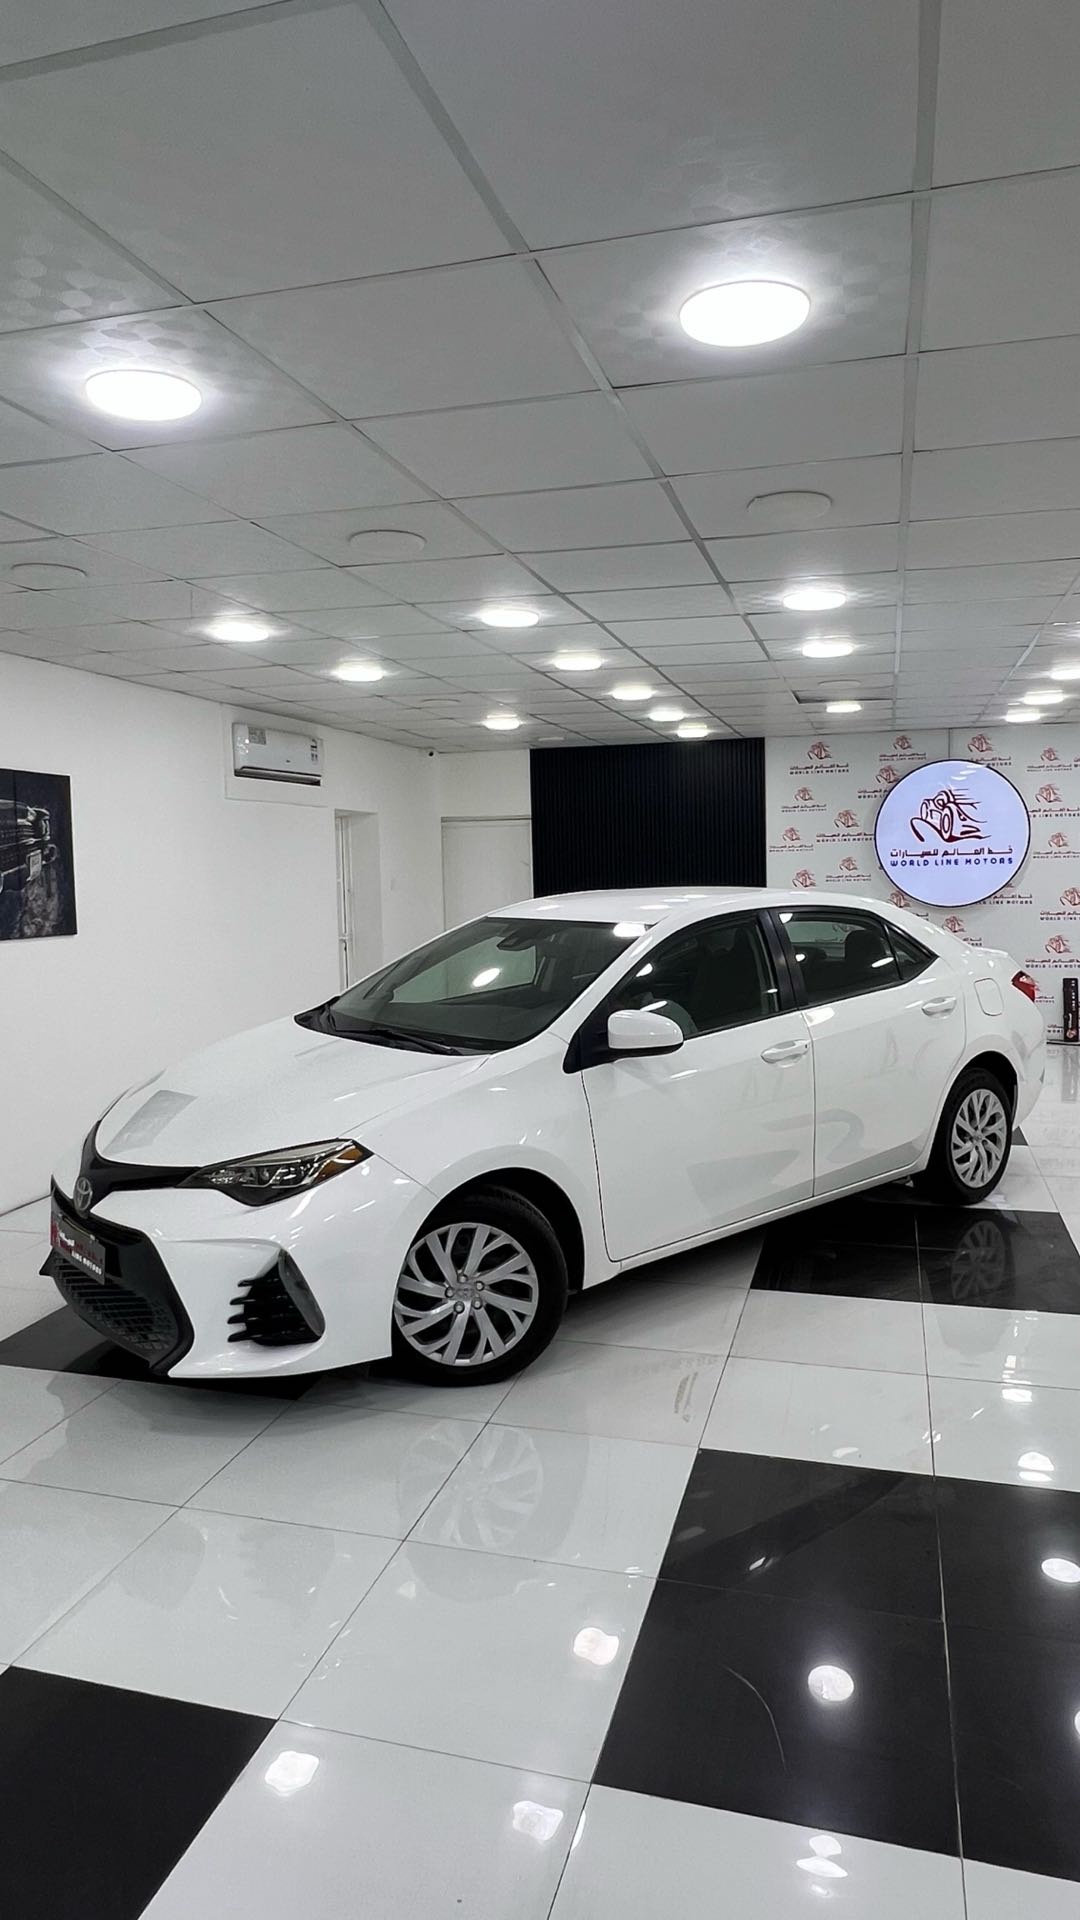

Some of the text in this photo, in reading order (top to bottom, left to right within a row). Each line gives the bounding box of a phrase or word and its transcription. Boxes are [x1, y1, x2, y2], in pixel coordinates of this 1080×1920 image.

[890, 845, 1012, 859] خط العالم للسيارات
[890, 857, 1012, 867] WORLD LINE MOTORS
